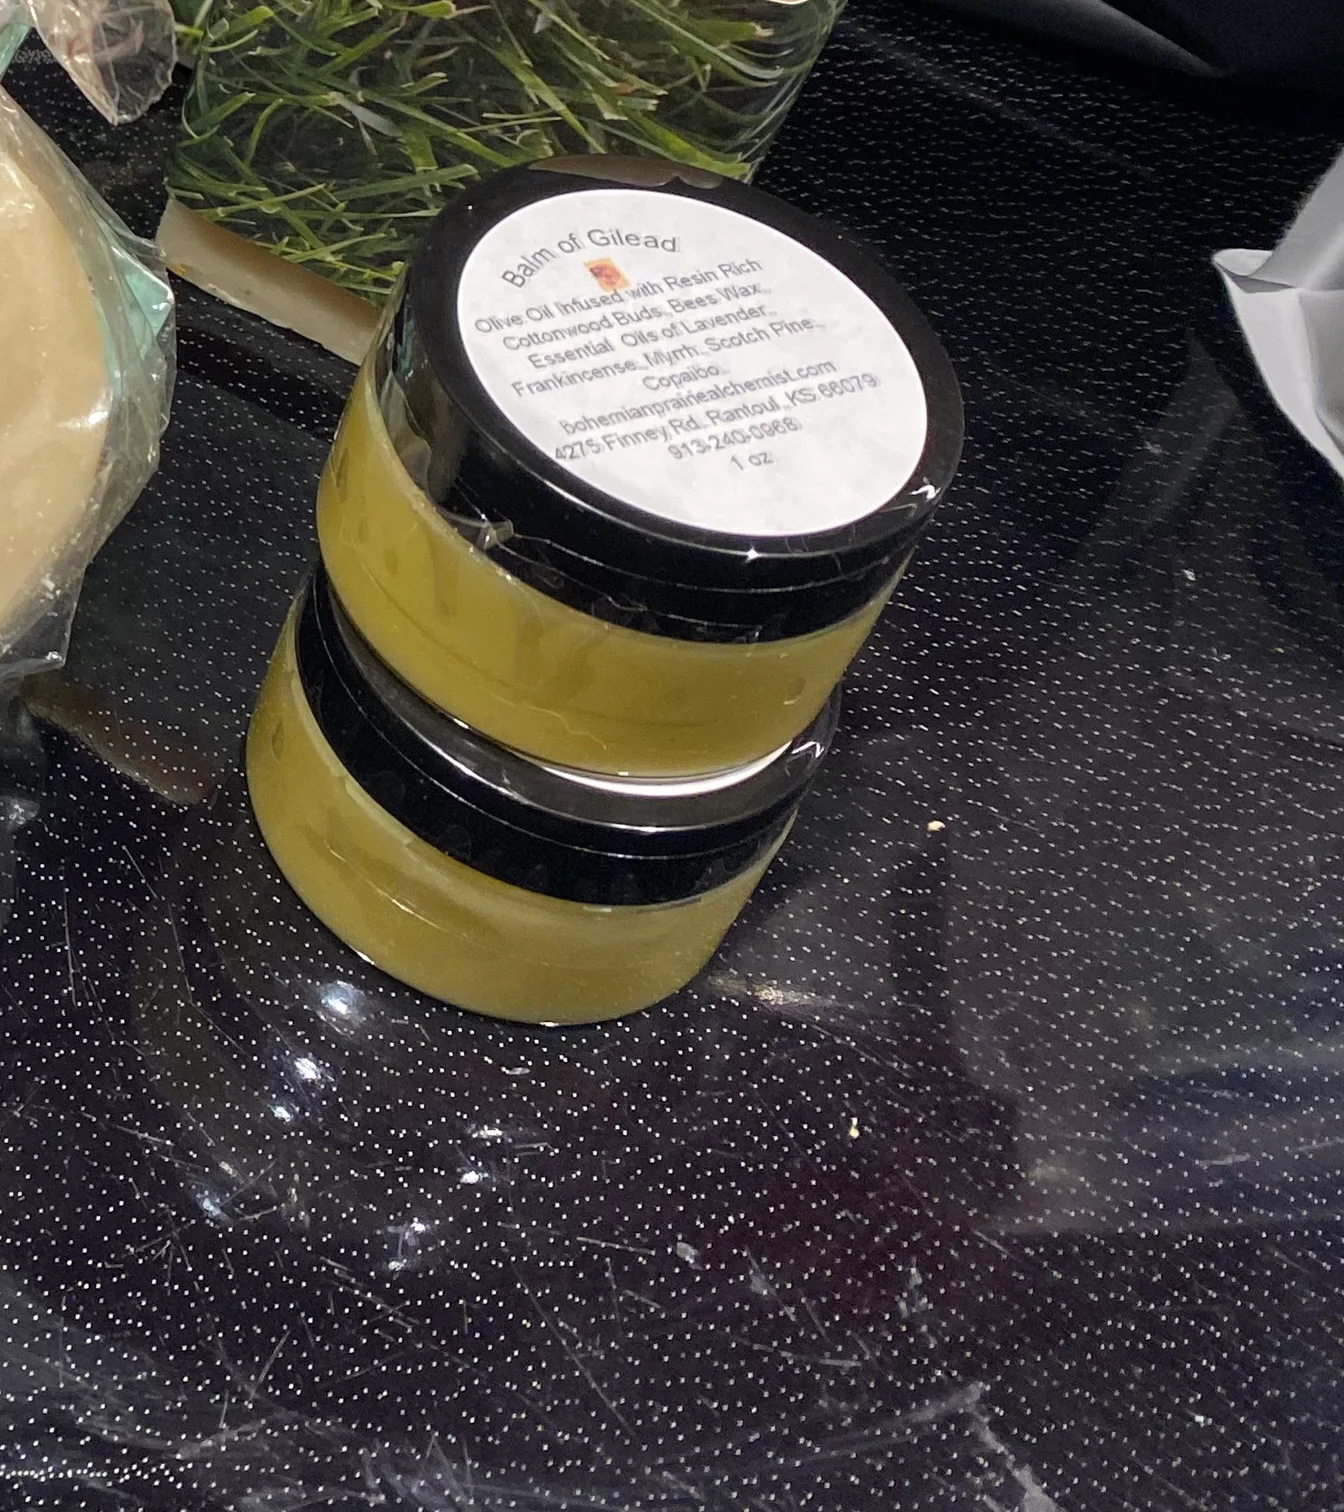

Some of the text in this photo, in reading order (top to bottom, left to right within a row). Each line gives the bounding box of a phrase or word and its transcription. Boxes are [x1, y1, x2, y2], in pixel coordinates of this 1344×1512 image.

[502, 228, 680, 288] Balm of Gilead
[474, 258, 764, 334] Olive Oil Infused with Resin Rich
[502, 316, 615, 351] Cottonwood
[667, 292, 719, 314] Bees
[527, 339, 615, 370] Essential
[620, 330, 660, 349] Oils
[661, 324, 684, 340] of
[704, 326, 770, 353] Scotch
[554, 438, 604, 462] 4275
[601, 426, 669, 453] Finney
[816, 372, 881, 400] 66079
[667, 416, 802, 461] 913-240-0968
[730, 451, 774, 472] 1 oz
